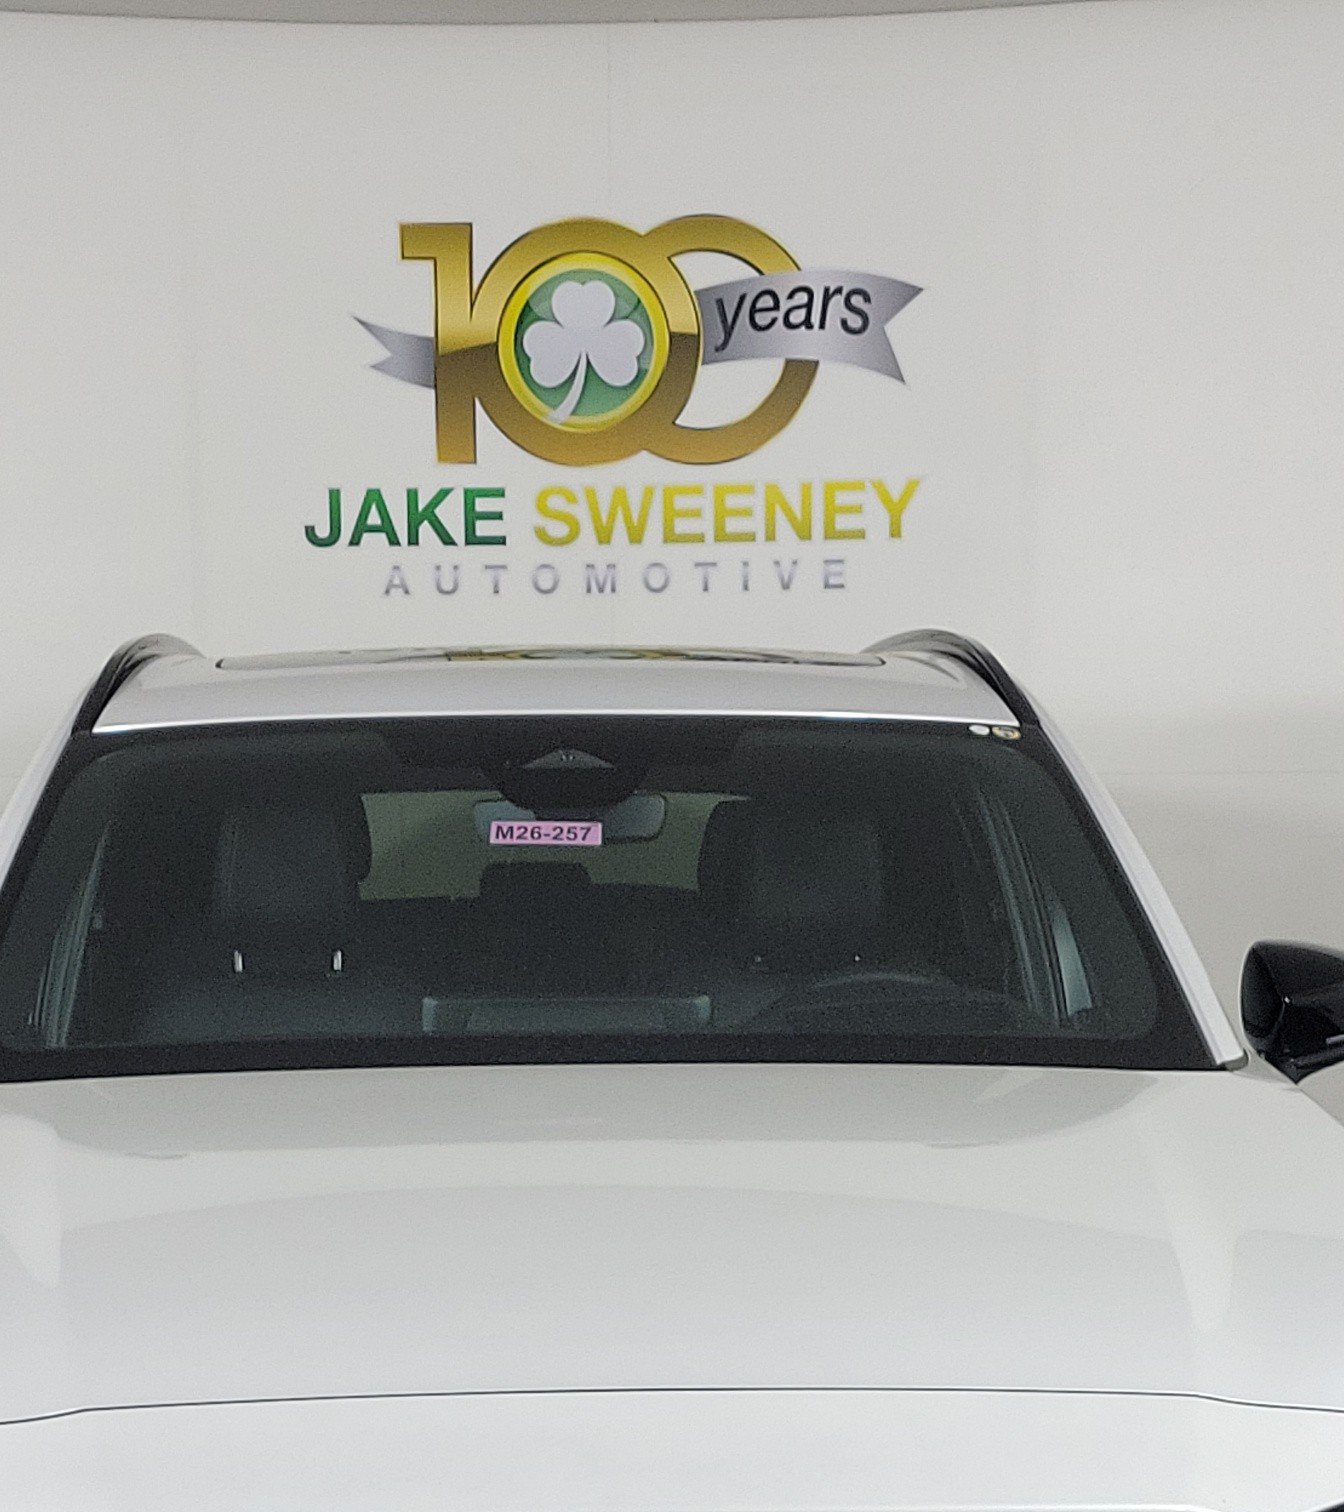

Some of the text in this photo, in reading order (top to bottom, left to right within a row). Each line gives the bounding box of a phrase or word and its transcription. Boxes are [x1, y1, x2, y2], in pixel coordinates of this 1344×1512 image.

[399, 213, 872, 467] 100 years
[304, 478, 922, 548] JAKE SWEENEY
[383, 558, 848, 597] AUTOMOTIVE
[494, 825, 592, 842] M26-257
